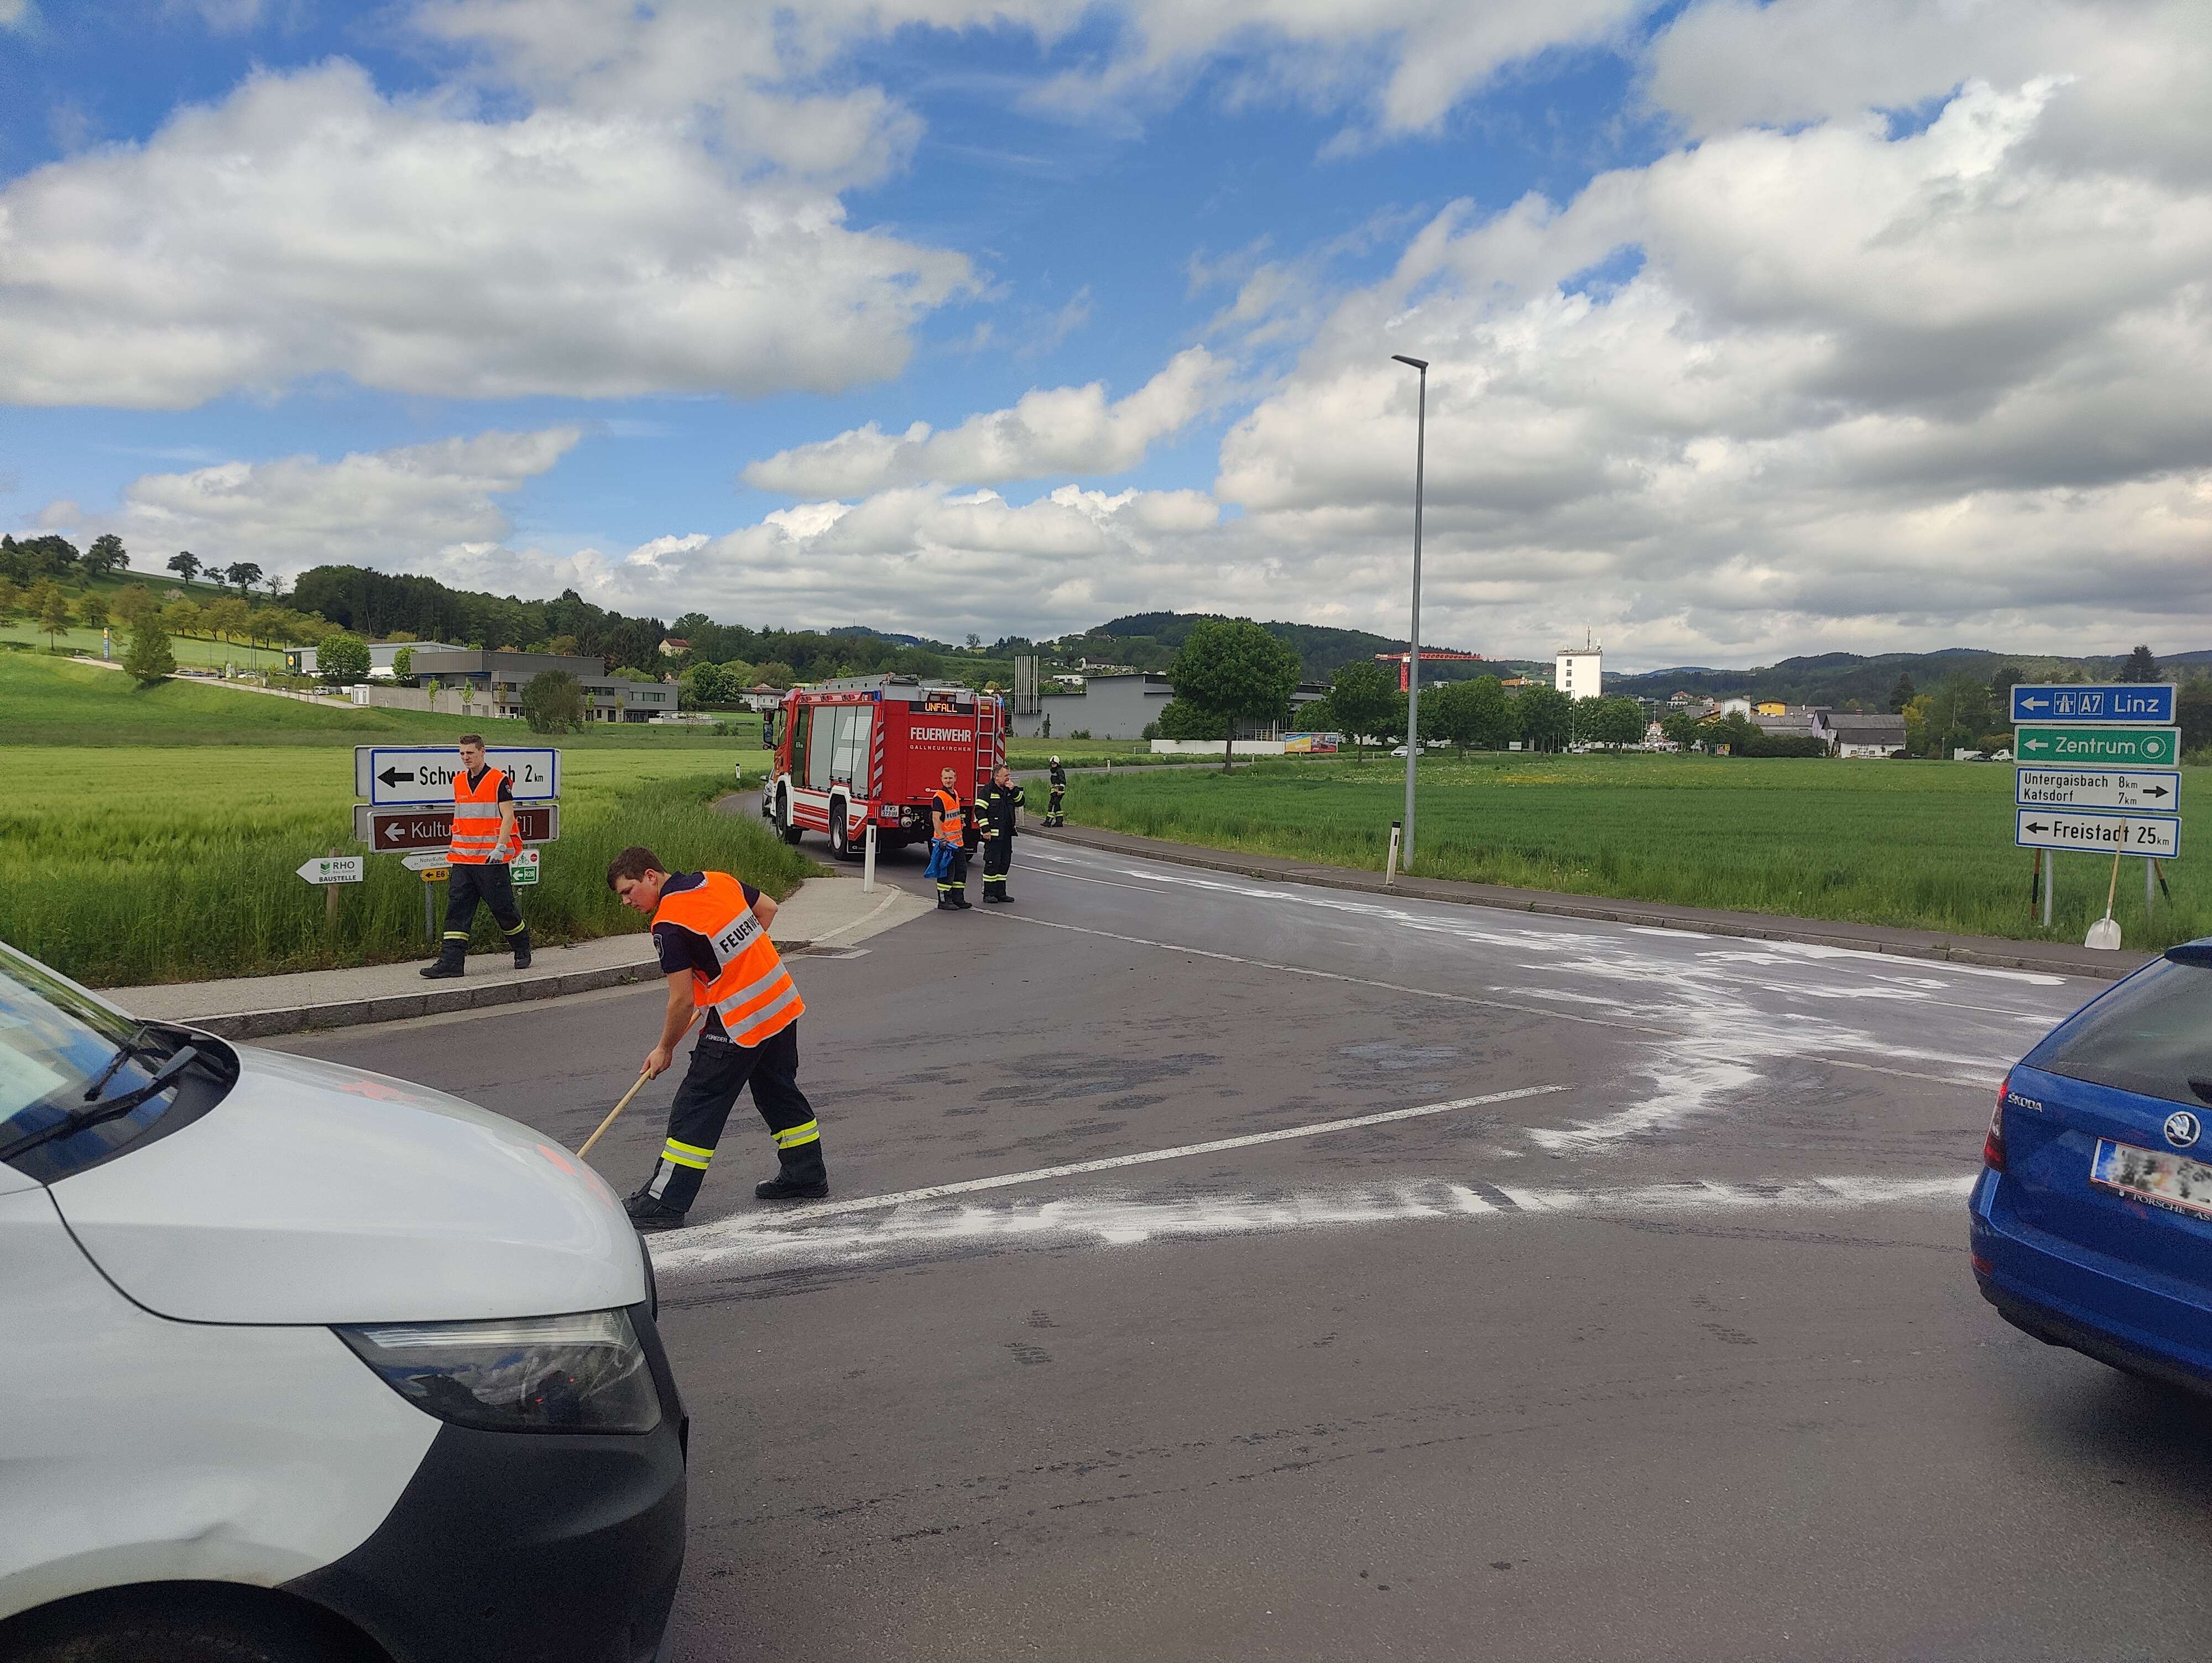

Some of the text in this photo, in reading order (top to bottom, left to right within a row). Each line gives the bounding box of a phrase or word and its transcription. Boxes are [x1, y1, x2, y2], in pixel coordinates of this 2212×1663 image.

[925, 702, 958, 713] UNFALL
[2080, 694, 2159, 713] A7 Linz
[910, 726, 972, 742] FEUERWEHR
[2055, 736, 2136, 755] Zentrum
[2025, 772, 2108, 788] Untergaisbach
[2024, 788, 2074, 802] Katsdorf
[411, 821, 451, 838] Kultu
[2053, 820, 2129, 843] Freistadt
[333, 861, 354, 870] RHO
[719, 914, 759, 954] FEUERWE
[705, 1034, 728, 1043] FÜREDER
[2133, 1194, 2185, 1215] PORSCHE
